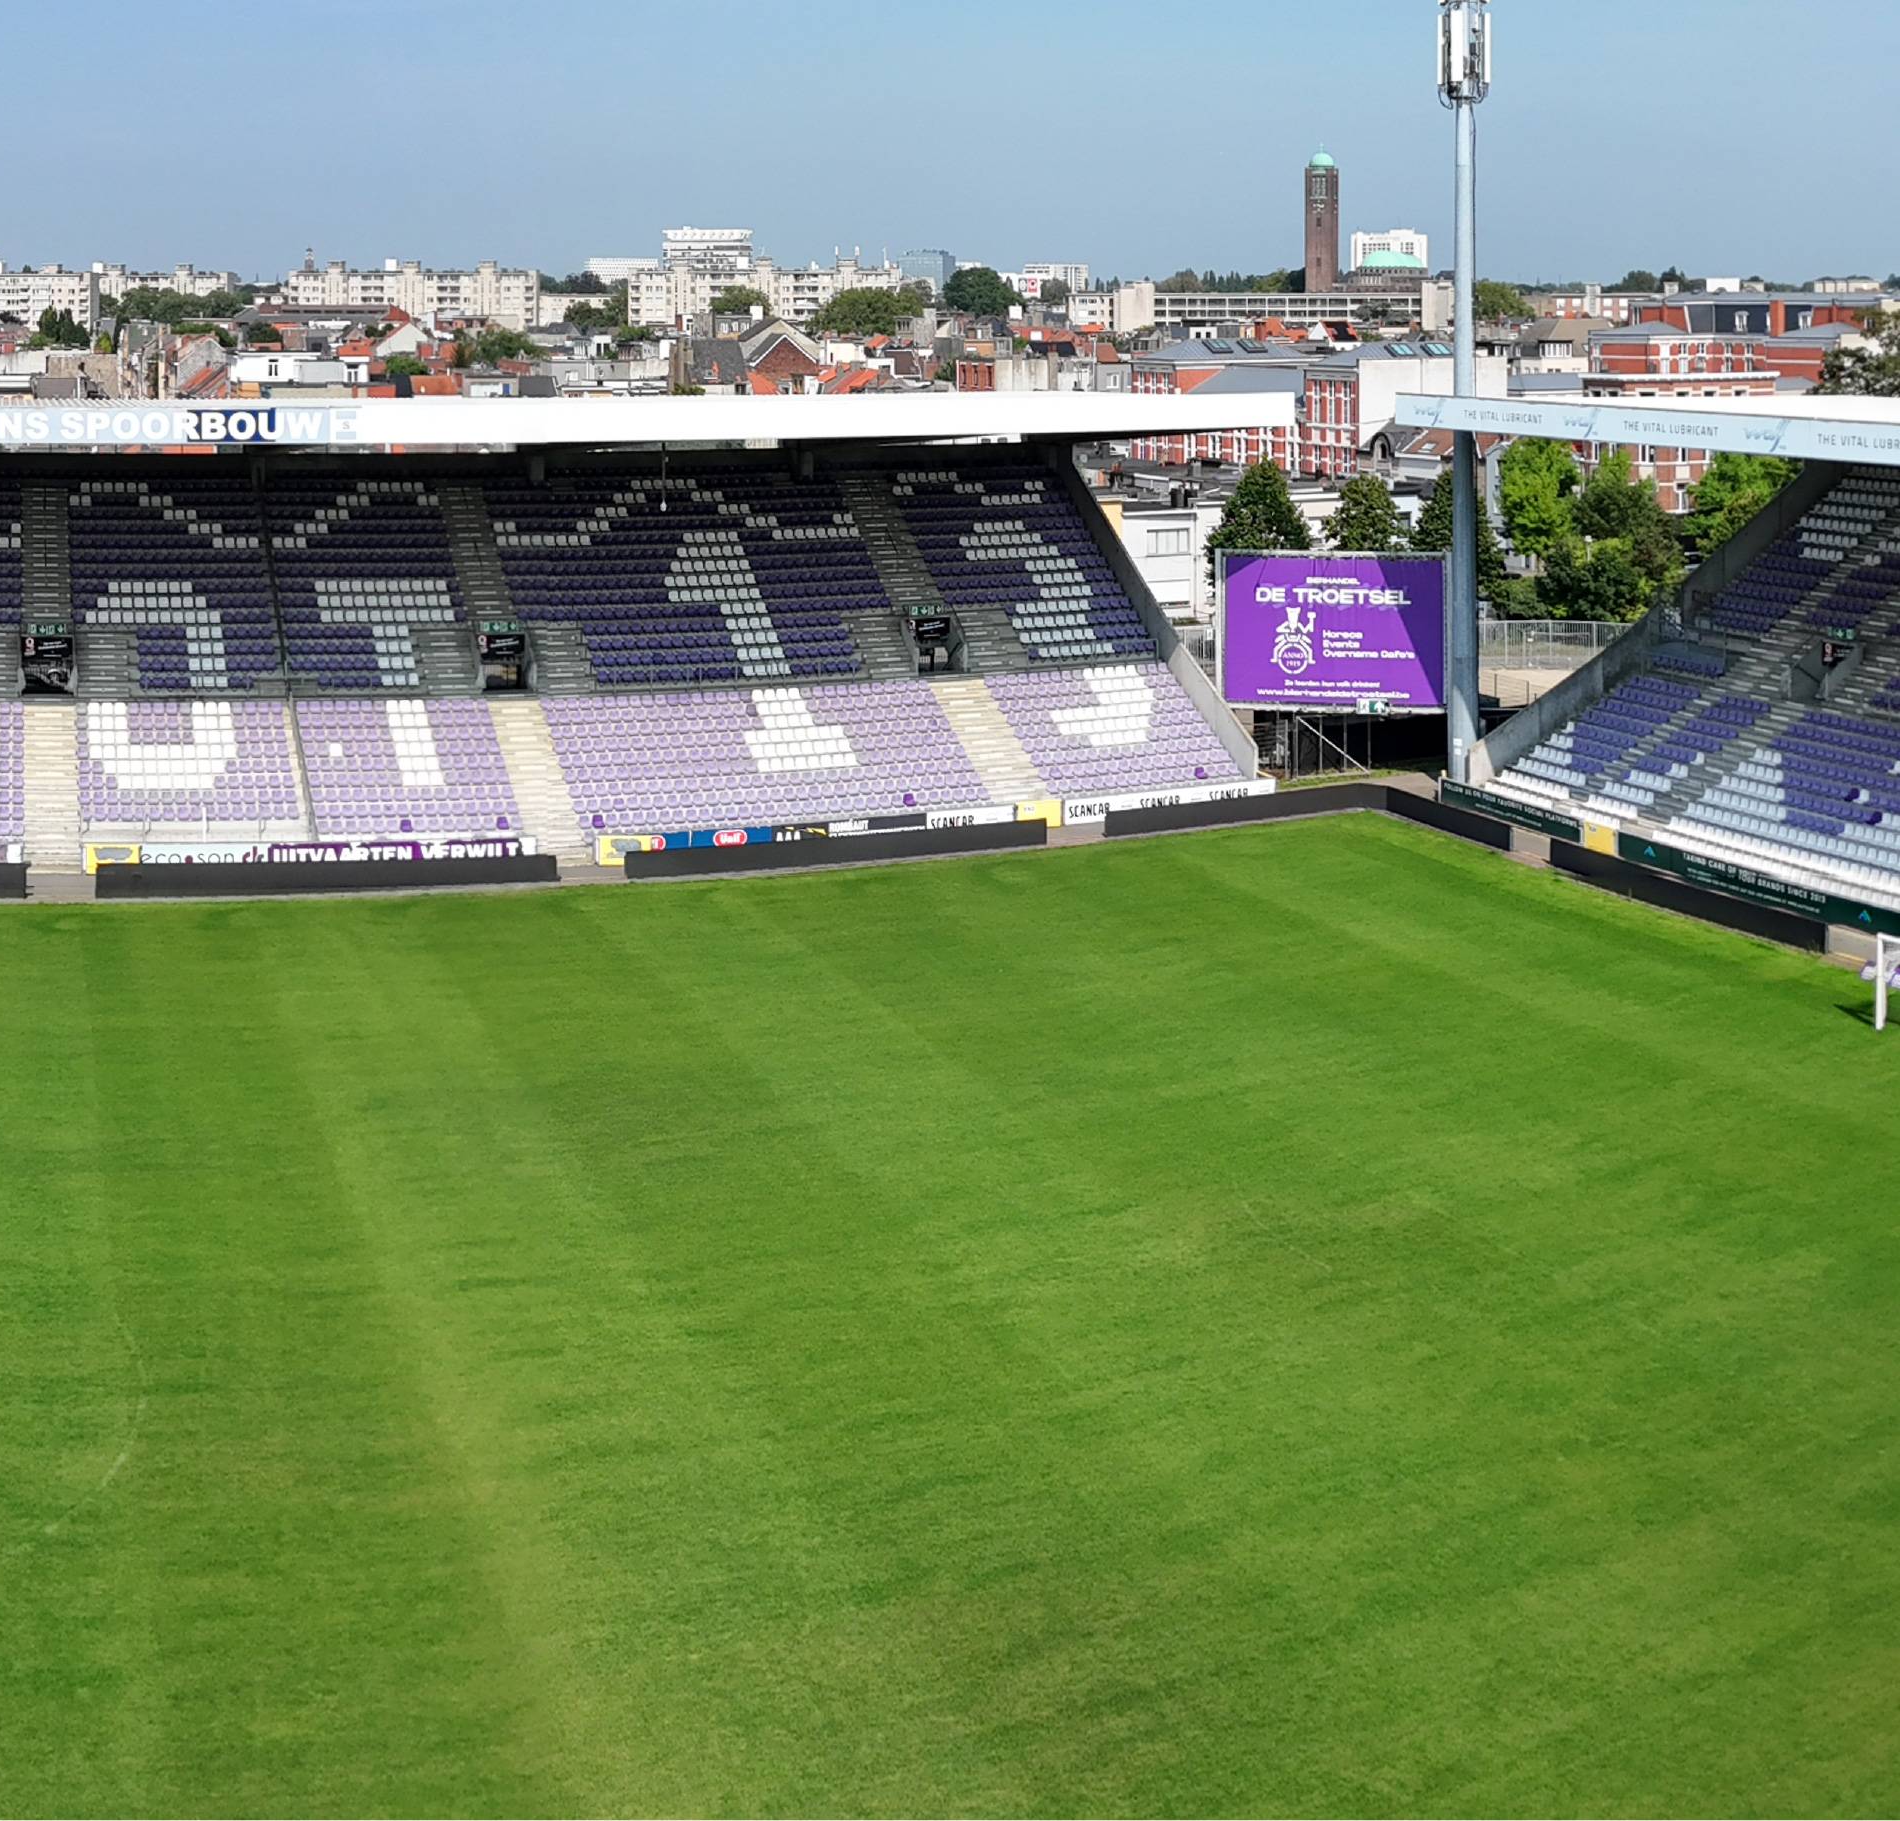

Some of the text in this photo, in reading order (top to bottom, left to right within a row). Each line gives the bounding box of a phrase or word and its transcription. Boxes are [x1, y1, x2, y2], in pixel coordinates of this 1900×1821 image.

[59, 409, 321, 441] SPOORBOUW
[1463, 409, 1542, 424] THE VITAL LUBRICANT
[1624, 420, 1718, 437] THE VITAL LUBRICANT
[1817, 433, 1836, 446] THE
[1841, 434, 1869, 448] VITAL
[1255, 587, 1412, 605] DE TROETSEL
[1069, 802, 1111, 819] SCANCAR
